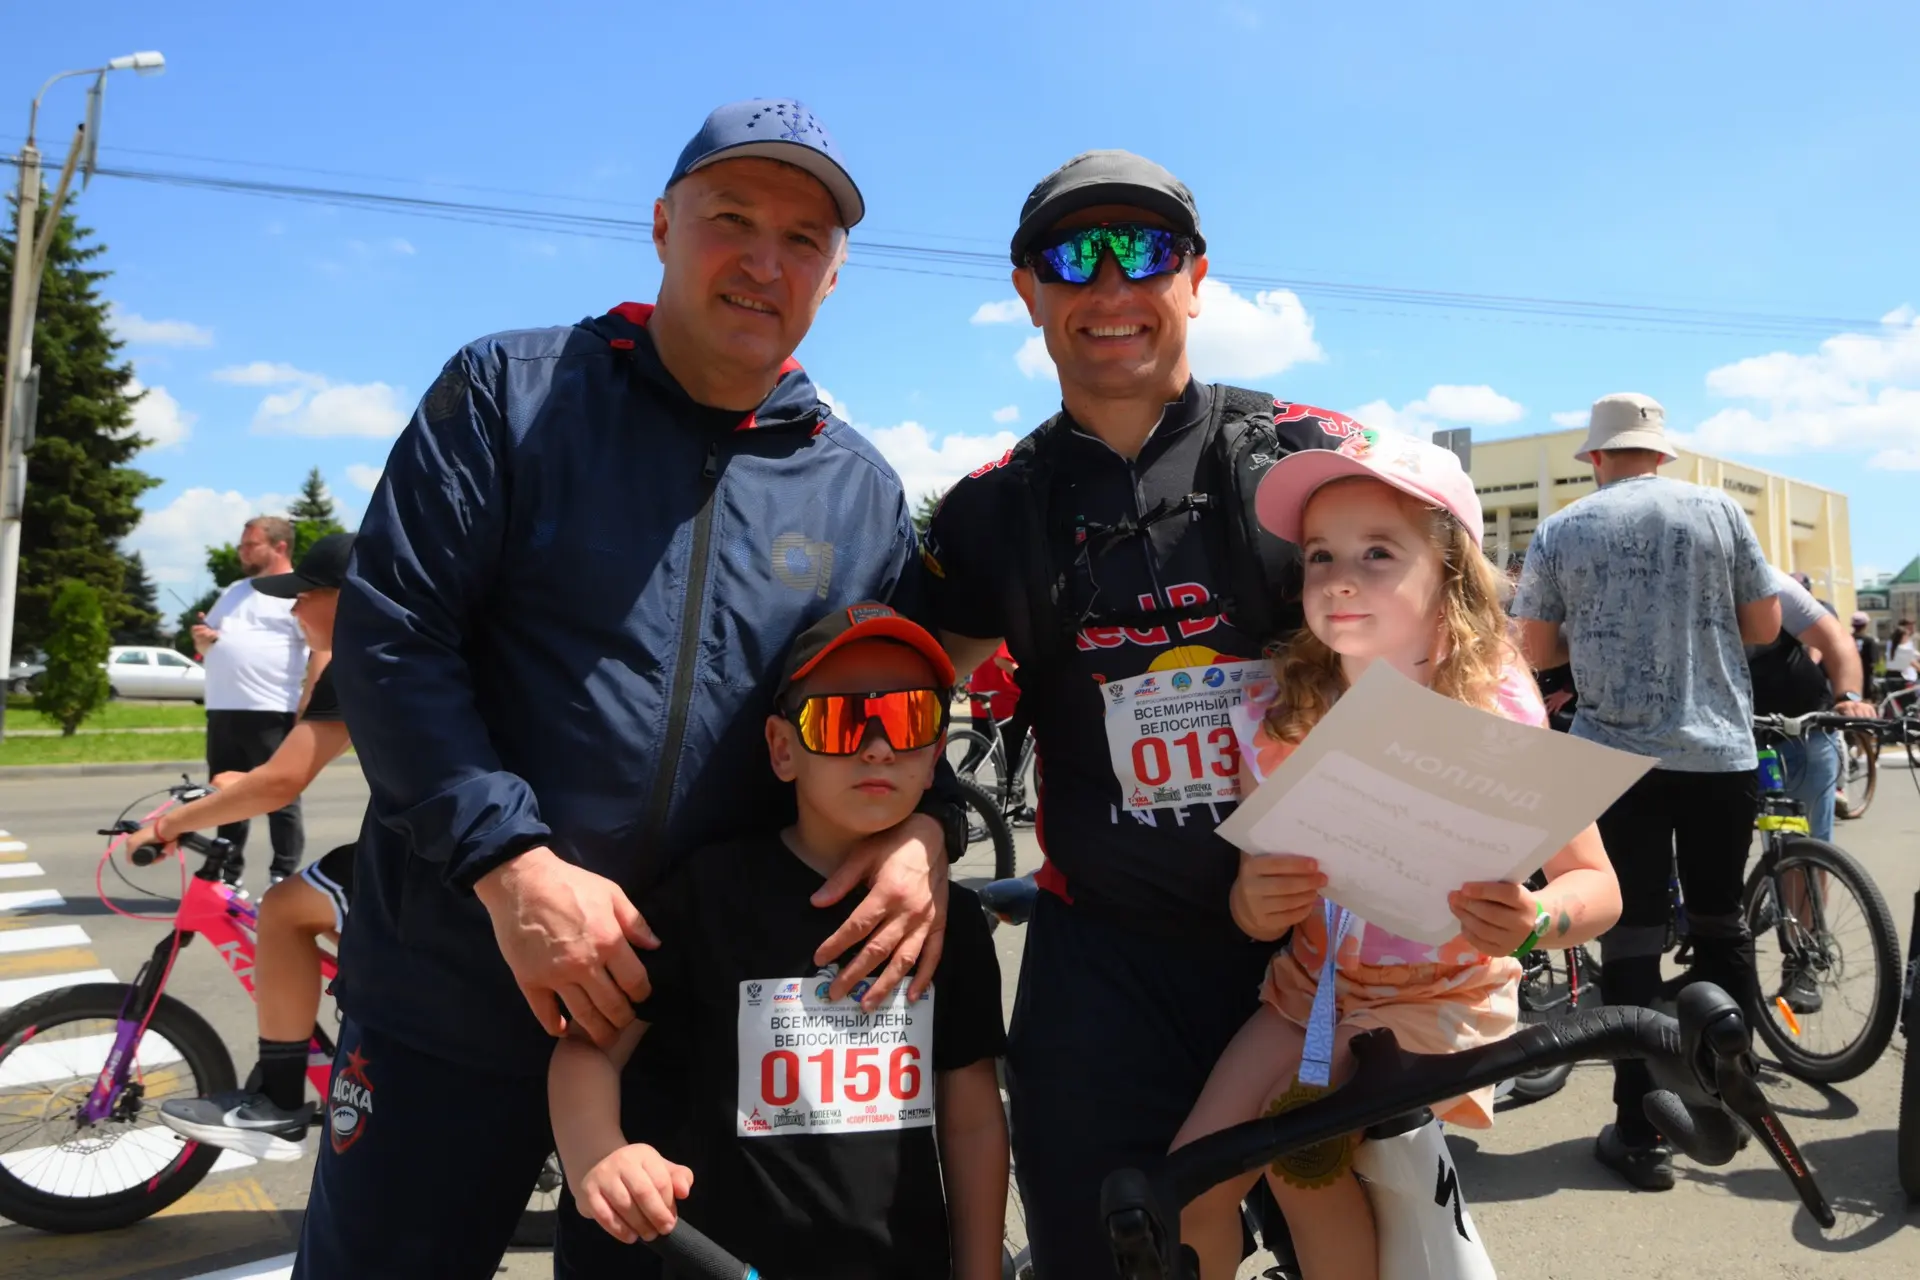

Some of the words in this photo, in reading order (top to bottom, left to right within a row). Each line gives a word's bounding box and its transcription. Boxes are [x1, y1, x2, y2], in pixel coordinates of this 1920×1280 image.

[1134, 694, 1228, 720] ВСЕМИРНЫЙ
[1131, 727, 1240, 787] 013
[771, 1011, 870, 1030] ВСЕМИРНЫЙ
[874, 1014, 913, 1028] ДЕНЬ
[775, 1031, 908, 1047] ВЕЛОСИПЕДИСТА
[761, 1046, 921, 1106] 0156
[332, 1077, 373, 1113] ЦСКА
